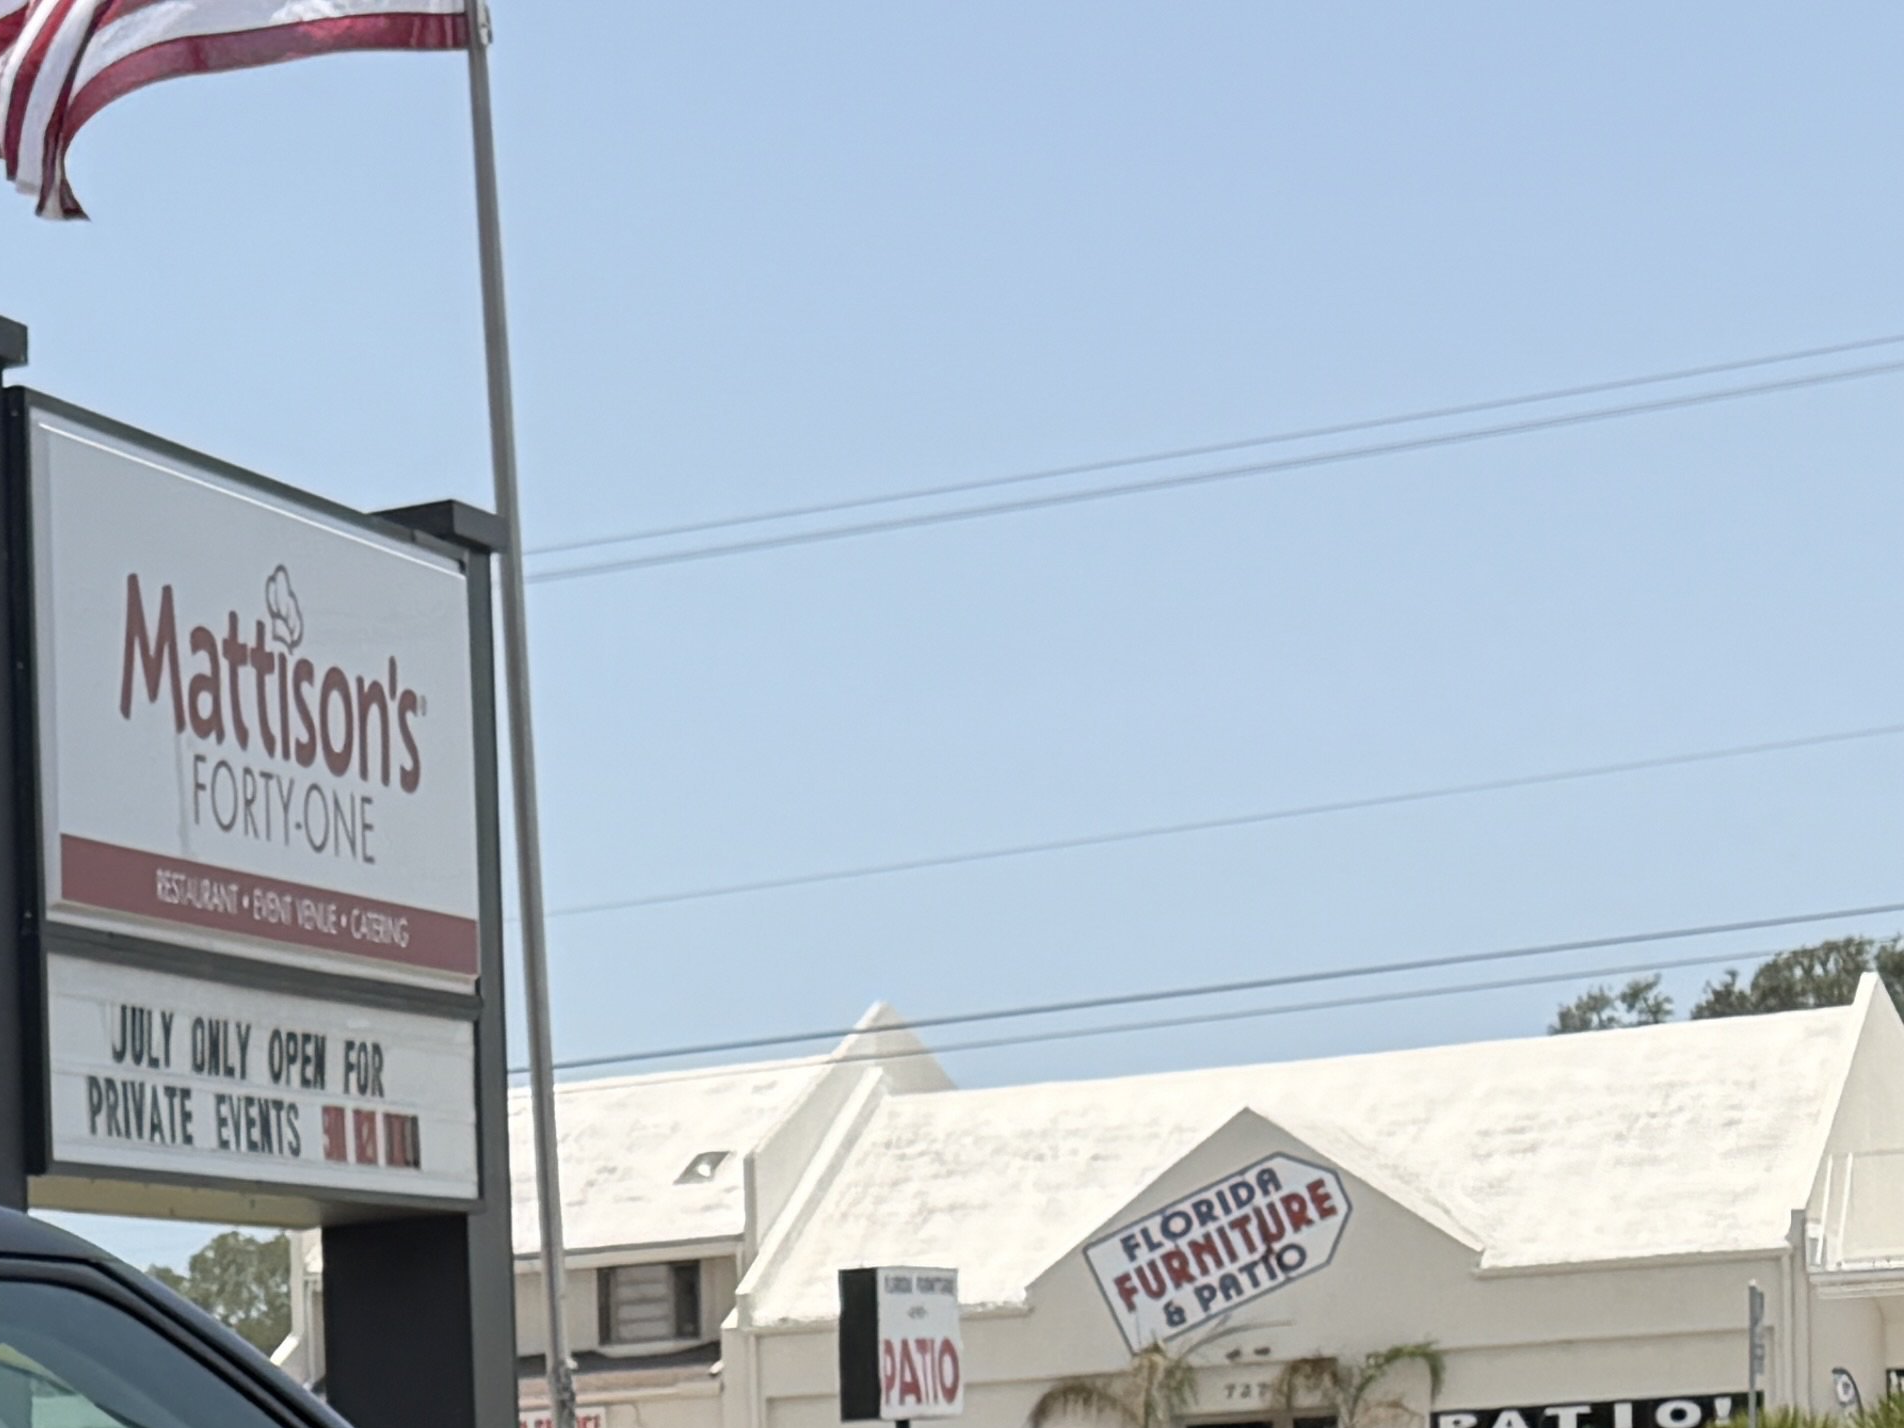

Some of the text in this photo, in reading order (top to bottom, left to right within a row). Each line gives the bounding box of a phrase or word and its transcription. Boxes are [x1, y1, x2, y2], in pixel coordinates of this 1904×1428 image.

[119, 572, 422, 795] Mattison's
[192, 753, 376, 865] FORTY-ONE
[155, 867, 410, 949] RESTAURANT EVENT VENUE CATERING
[111, 1003, 385, 1098] JULY ONLY OPEN FOR
[87, 1075, 193, 1145] PRIVATE
[214, 1093, 302, 1158] EVENTS
[1112, 1177, 1339, 1314] FURNITURE
[1119, 1166, 1283, 1263] FLORIDA
[1162, 1243, 1308, 1328] & PATIO
[883, 1336, 961, 1407] PATIO
